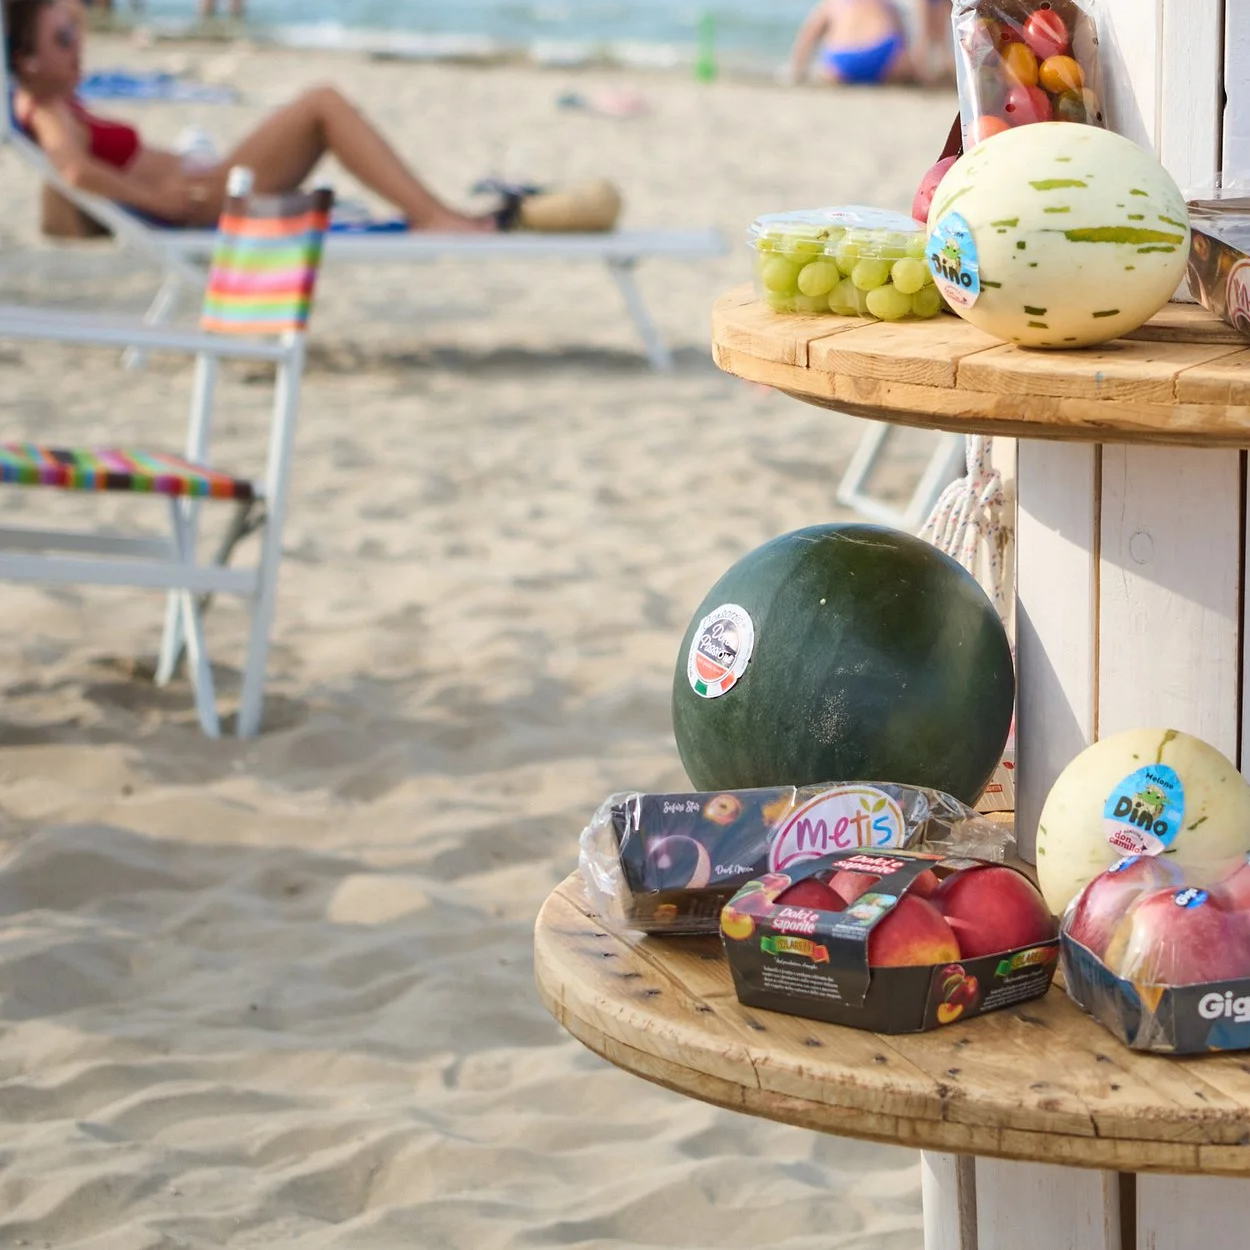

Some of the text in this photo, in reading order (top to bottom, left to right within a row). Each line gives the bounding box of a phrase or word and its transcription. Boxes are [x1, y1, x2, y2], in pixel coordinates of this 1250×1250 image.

[1145, 772, 1174, 790] Melone
[1113, 795, 1168, 837] Dino
[1113, 830, 1132, 844] don
[779, 907, 820, 922] Dolci e
[771, 917, 816, 934] saporite
